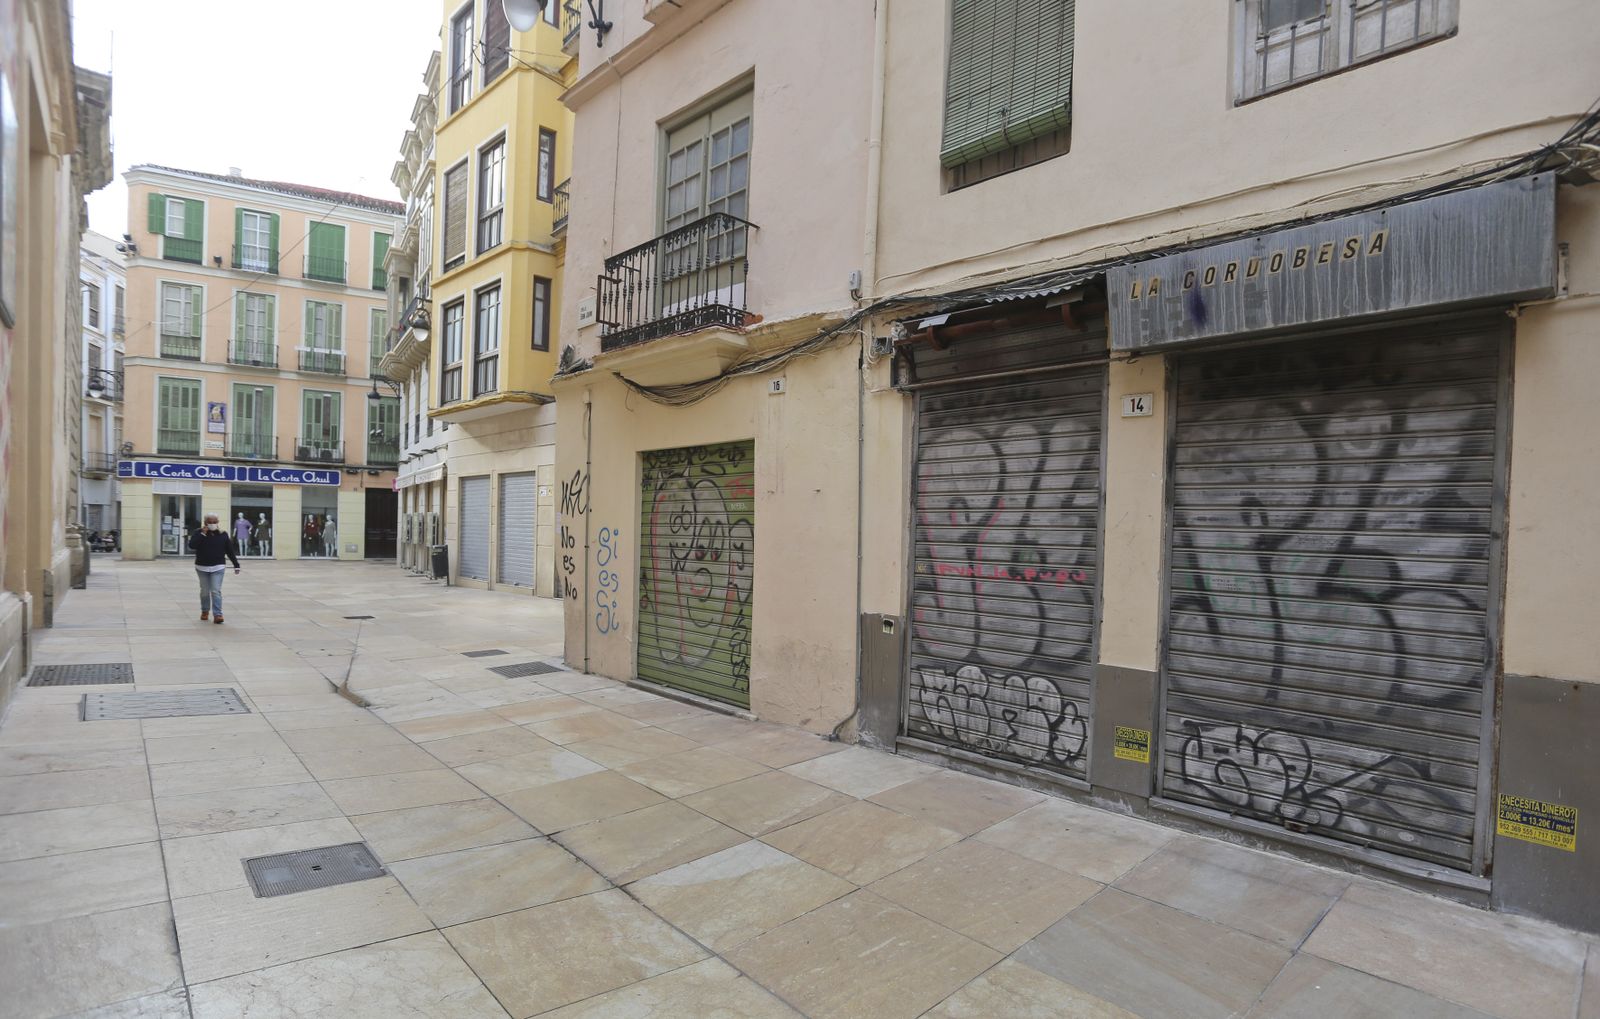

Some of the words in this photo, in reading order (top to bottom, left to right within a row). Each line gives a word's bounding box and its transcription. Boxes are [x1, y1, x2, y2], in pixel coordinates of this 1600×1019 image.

[1130, 278, 1160, 300] LA
[1182, 232, 1386, 291] CORDOBESA
[773, 380, 780, 391] 16
[1130, 397, 1145, 413] 14
[145, 463, 158, 477] La
[160, 465, 192, 478] Costa
[195, 466, 226, 479] Azul
[258, 469, 270, 481] La
[271, 470, 300, 483] Costa
[302, 470, 330, 484] Azul
[561, 526, 575, 549] No
[597, 527, 619, 567] Si
[563, 554, 575, 575] es
[564, 576, 578, 601] No
[598, 569, 619, 593] es
[1541, 803, 1576, 820] DINERO?
